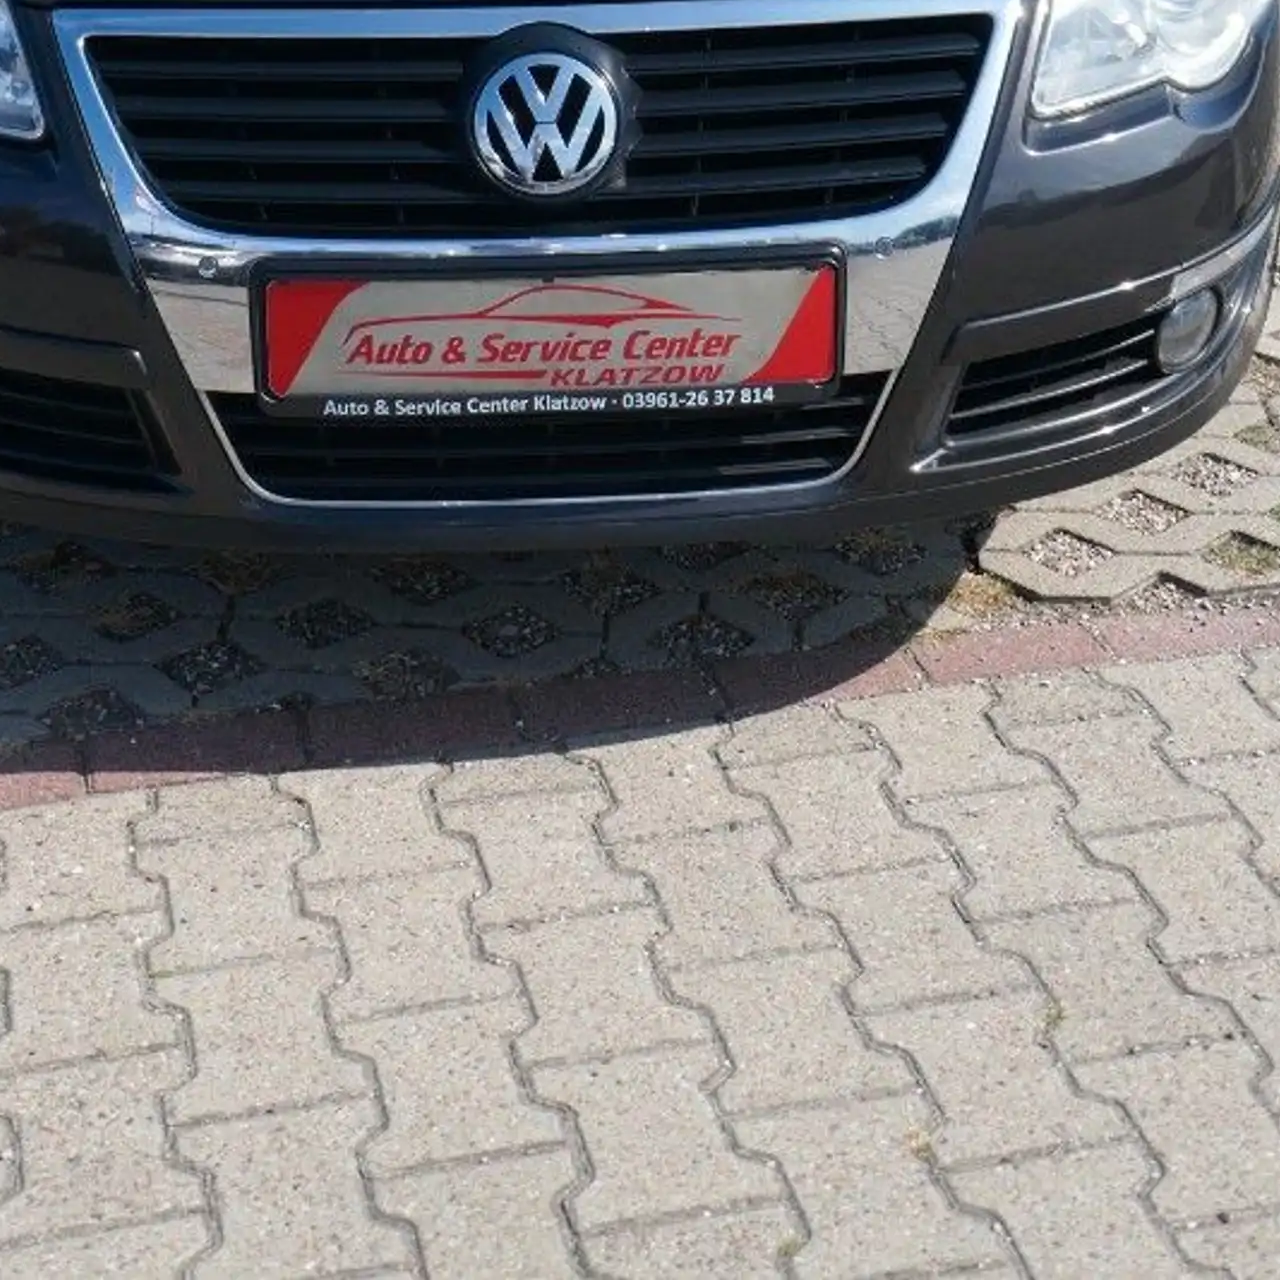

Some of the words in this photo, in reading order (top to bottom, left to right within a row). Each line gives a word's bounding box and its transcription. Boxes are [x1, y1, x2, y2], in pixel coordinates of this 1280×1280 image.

[346, 334, 434, 365] Auto
[441, 335, 467, 363] &
[477, 332, 612, 363] Service
[623, 328, 741, 360] Center
[549, 364, 725, 387] KLATZOW
[323, 398, 369, 416] Auto
[374, 398, 390, 416] &
[395, 397, 461, 416] Service
[467, 396, 528, 414] Center
[533, 394, 608, 411] Klatzow
[622, 391, 708, 409] 03961-26
[715, 390, 735, 407] 37
[740, 386, 775, 404] 814
